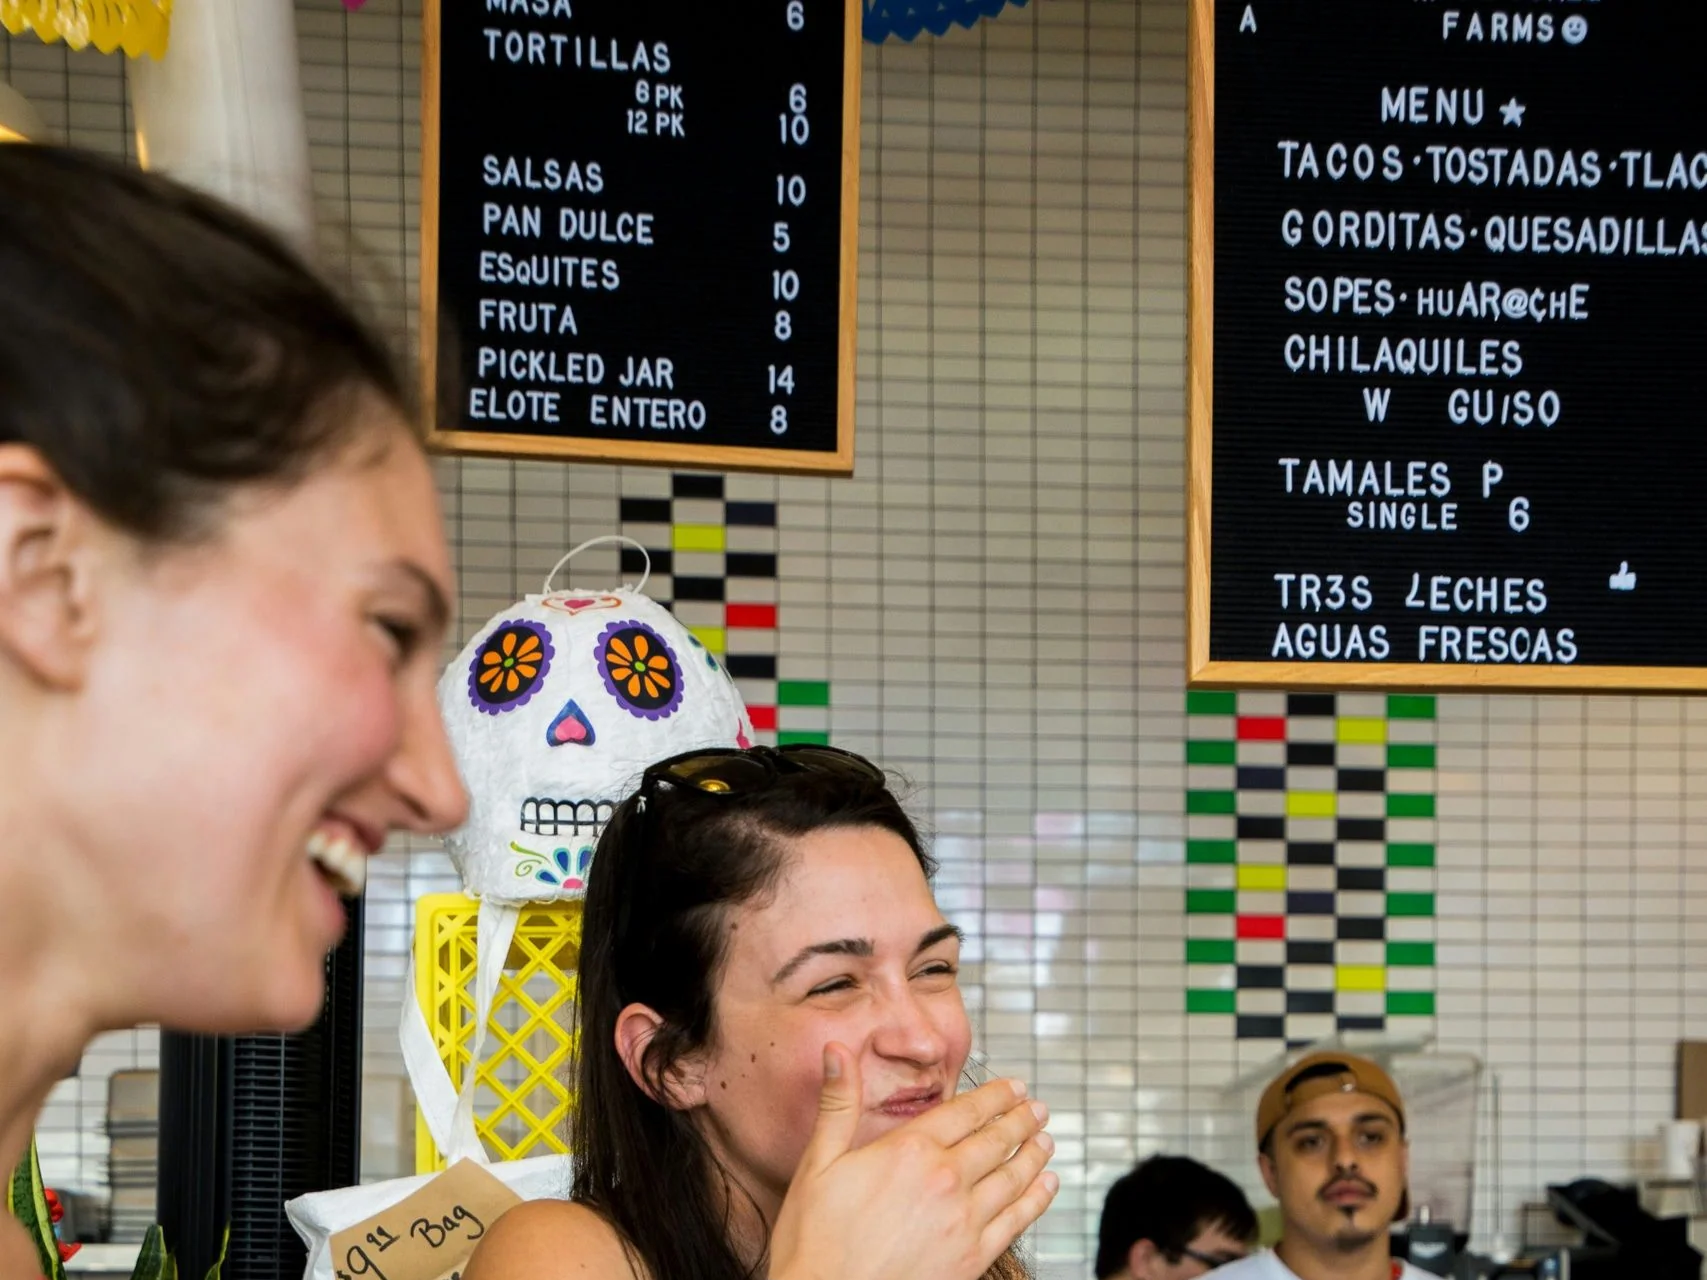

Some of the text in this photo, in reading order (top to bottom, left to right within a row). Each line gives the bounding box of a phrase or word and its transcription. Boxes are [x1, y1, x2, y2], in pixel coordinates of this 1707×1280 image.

[787, 1, 804, 31] 6
[1240, 5, 1256, 32] A
[1442, 11, 1554, 42] FARMS
[484, 28, 671, 74] TORTILLAS
[636, 80, 807, 113] 6 PK 6
[1381, 86, 1484, 126] MENU
[627, 109, 809, 145] 12 PK 10
[483, 155, 806, 206] SALSAS 10
[484, 202, 790, 253] PAN DULCE 5
[773, 269, 799, 301] 10
[480, 299, 792, 341] FRUTA 8
[478, 346, 795, 396] PICKLED JAR 14
[1285, 333, 1523, 378] CHILAQUILES
[470, 387, 788, 435] ELOTE ENTERO 8
[1363, 387, 1391, 423] W
[1278, 457, 1504, 498] TAMALES P
[1346, 496, 1530, 533] SINGLE 6
[1273, 572, 1547, 615] TR3S LECHES
[1271, 621, 1390, 660] AGUAS
[410, 1204, 485, 1249] Bag
